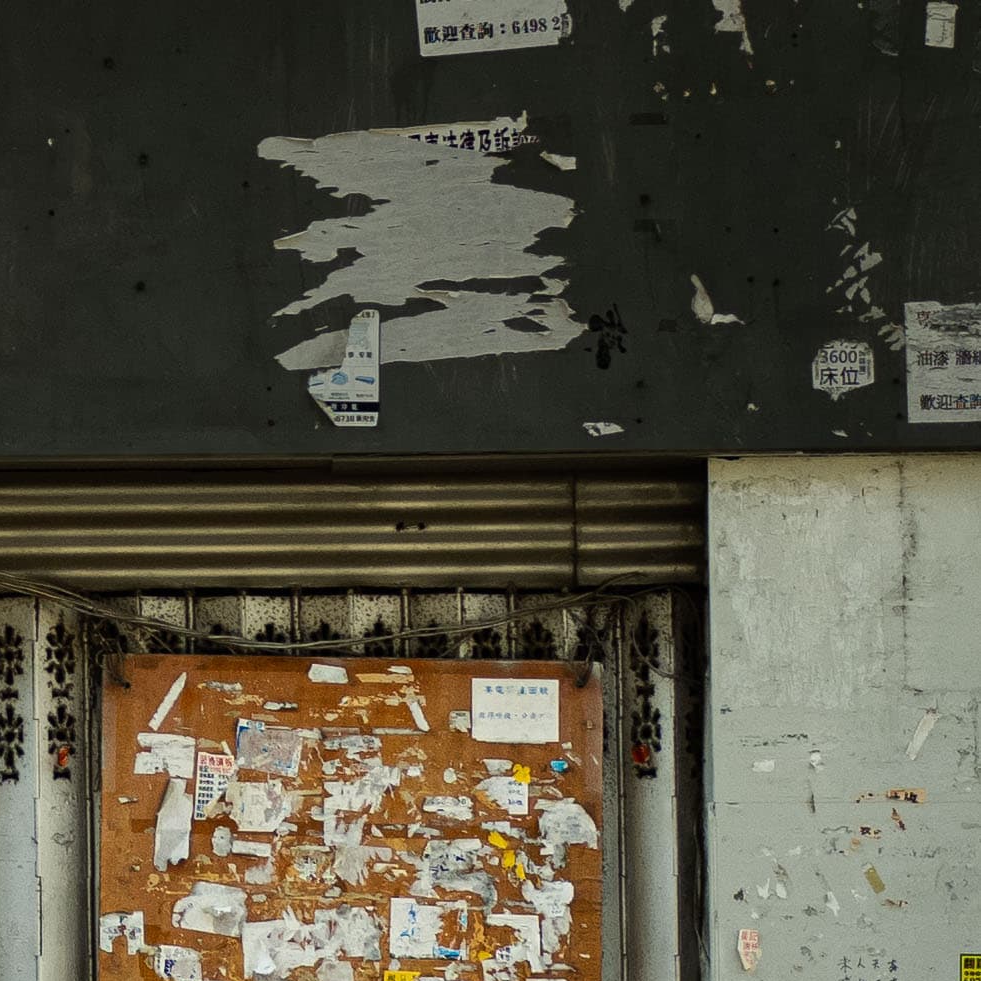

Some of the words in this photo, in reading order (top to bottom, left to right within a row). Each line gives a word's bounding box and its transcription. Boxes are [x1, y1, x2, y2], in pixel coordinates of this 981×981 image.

[819, 349, 857, 364] 3600
[917, 350, 949, 366] 油漆
[820, 368, 859, 386] 床位
